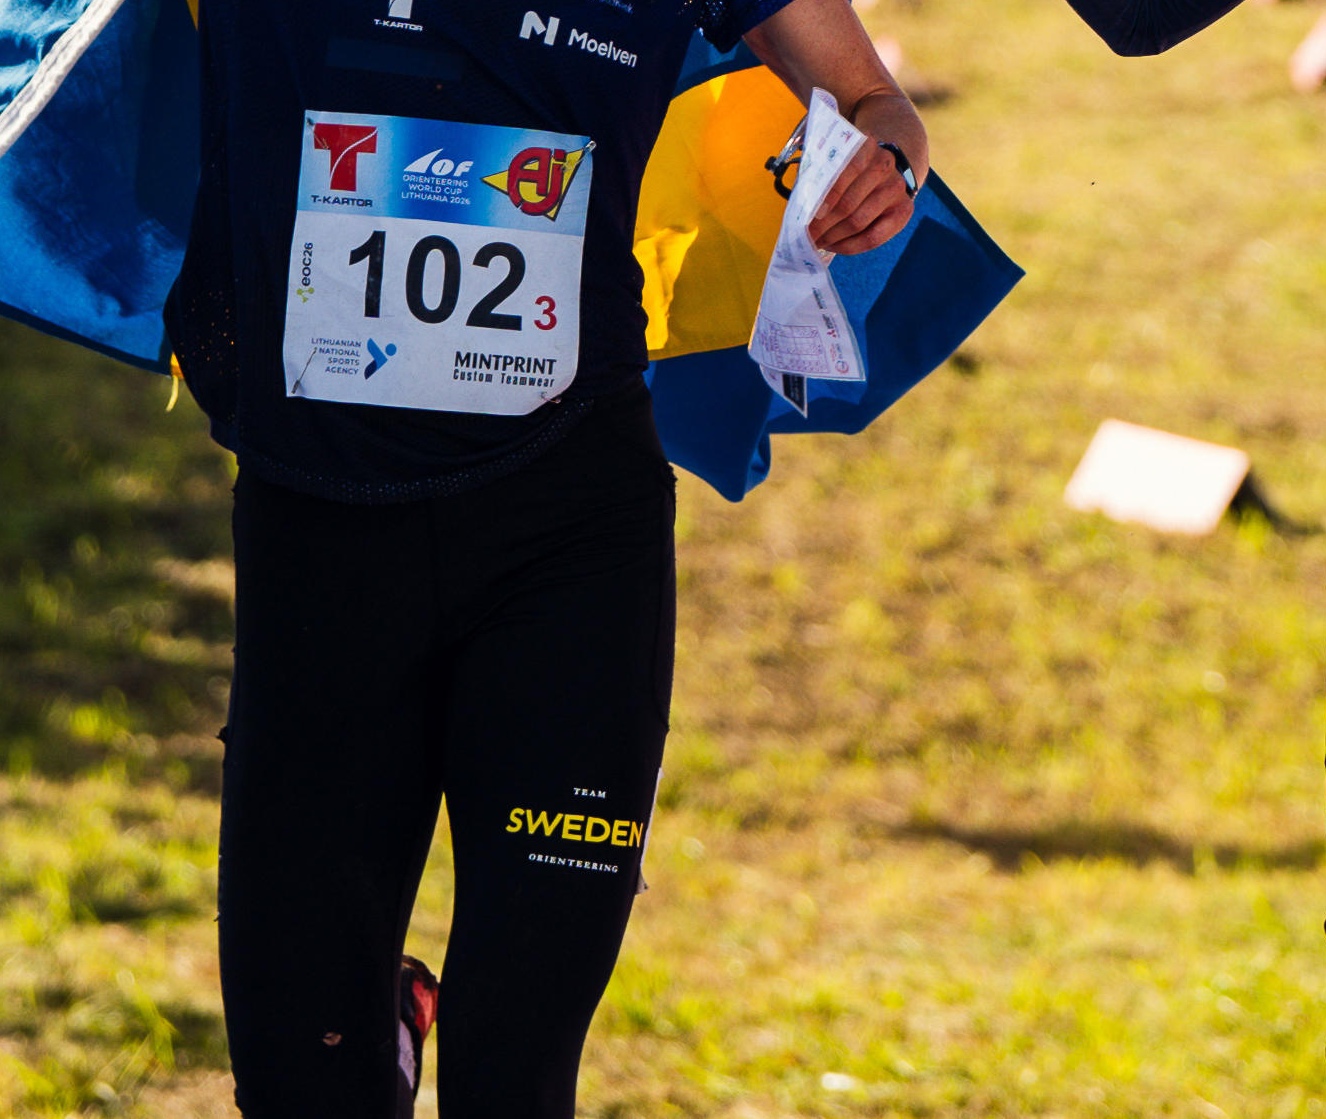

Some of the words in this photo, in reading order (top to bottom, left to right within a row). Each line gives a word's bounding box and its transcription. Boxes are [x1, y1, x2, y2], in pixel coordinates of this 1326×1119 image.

[374, 18, 423, 31] T-KARTOR
[568, 28, 638, 68] Moelven
[402, 174, 469, 188] ORIENTEERING
[408, 184, 442, 194] WORLD
[444, 187, 463, 195] CUP
[311, 194, 374, 208] T-KARTOR
[401, 191, 448, 203] LITHUANIA
[450, 196, 471, 205] 2026
[349, 230, 527, 331] 102
[533, 295, 557, 331] 3
[311, 337, 362, 348] LITHUANIAN
[319, 347, 361, 357] NATIONAL
[328, 357, 360, 366] SPORTS
[454, 350, 557, 375] MINTPRINT
[325, 366, 359, 375] AGENCY
[453, 368, 493, 383] Custom
[500, 372, 555, 388] Teamwear
[573, 787, 607, 799] TEAM
[505, 807, 644, 848] SWEDEN
[528, 853, 619, 873] ORIENTEERING
